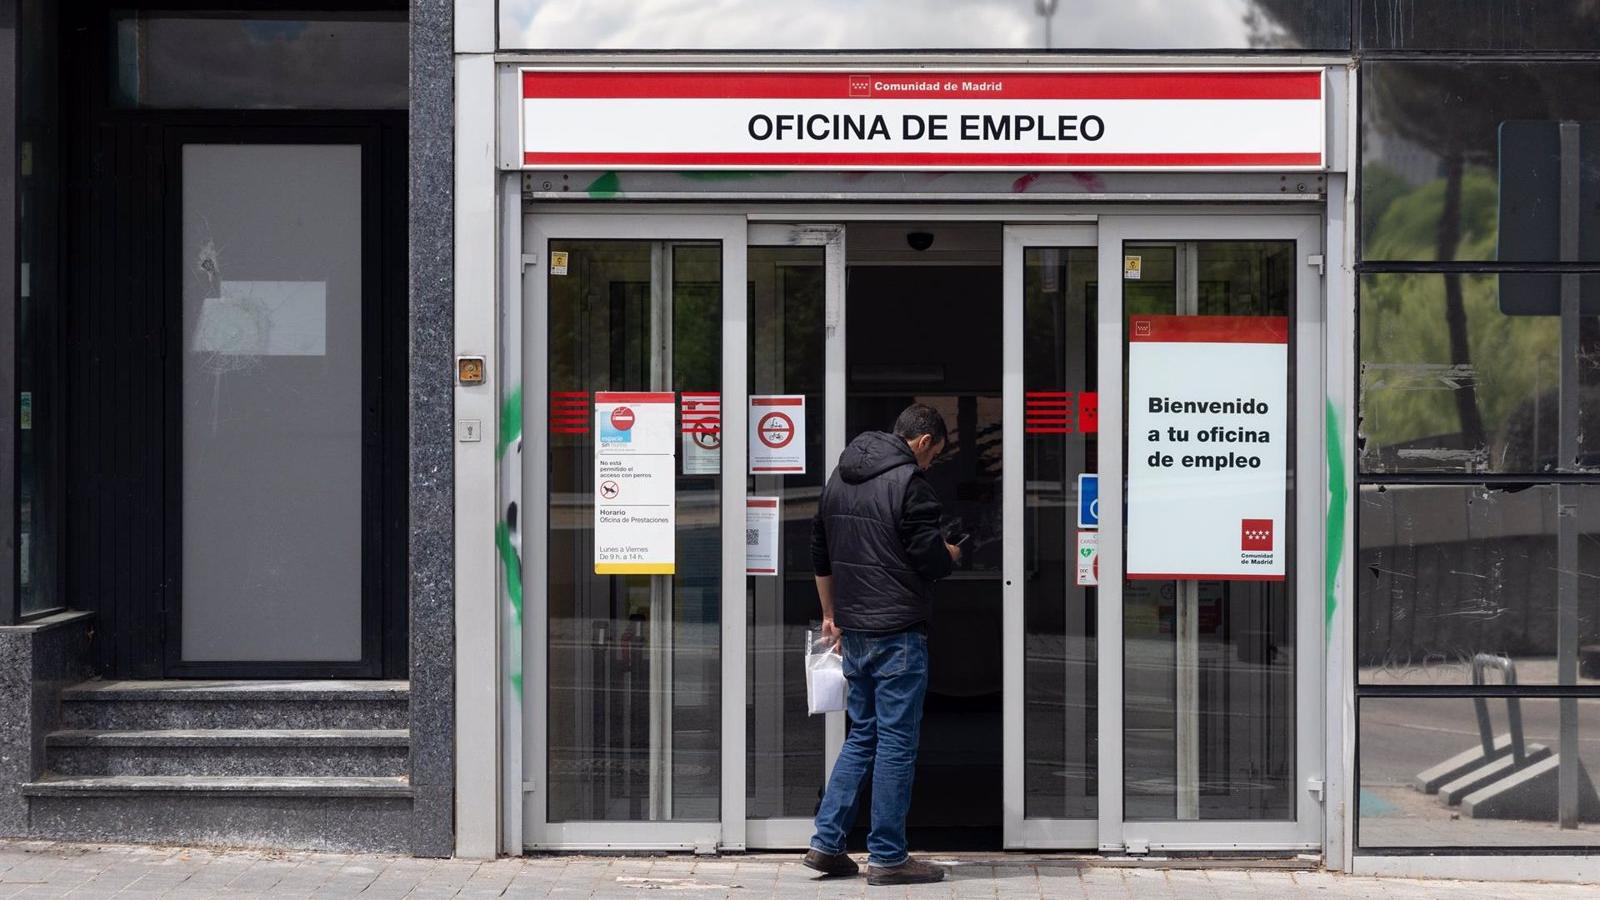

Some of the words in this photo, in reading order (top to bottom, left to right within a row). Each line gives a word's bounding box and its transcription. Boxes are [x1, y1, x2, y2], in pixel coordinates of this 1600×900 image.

[874, 81, 940, 91] Comunidad
[944, 81, 958, 91] de
[962, 81, 1003, 91] Madrid
[747, 114, 891, 141] OFICINA
[902, 114, 949, 141] DE
[960, 114, 1106, 142] EMPLEO
[1148, 396, 1269, 416] Bienvenido
[1147, 429, 1160, 443] a
[1167, 426, 1190, 443] tu
[1197, 425, 1271, 444] oficina
[1147, 450, 1174, 468] de
[1181, 451, 1262, 472] empleo
